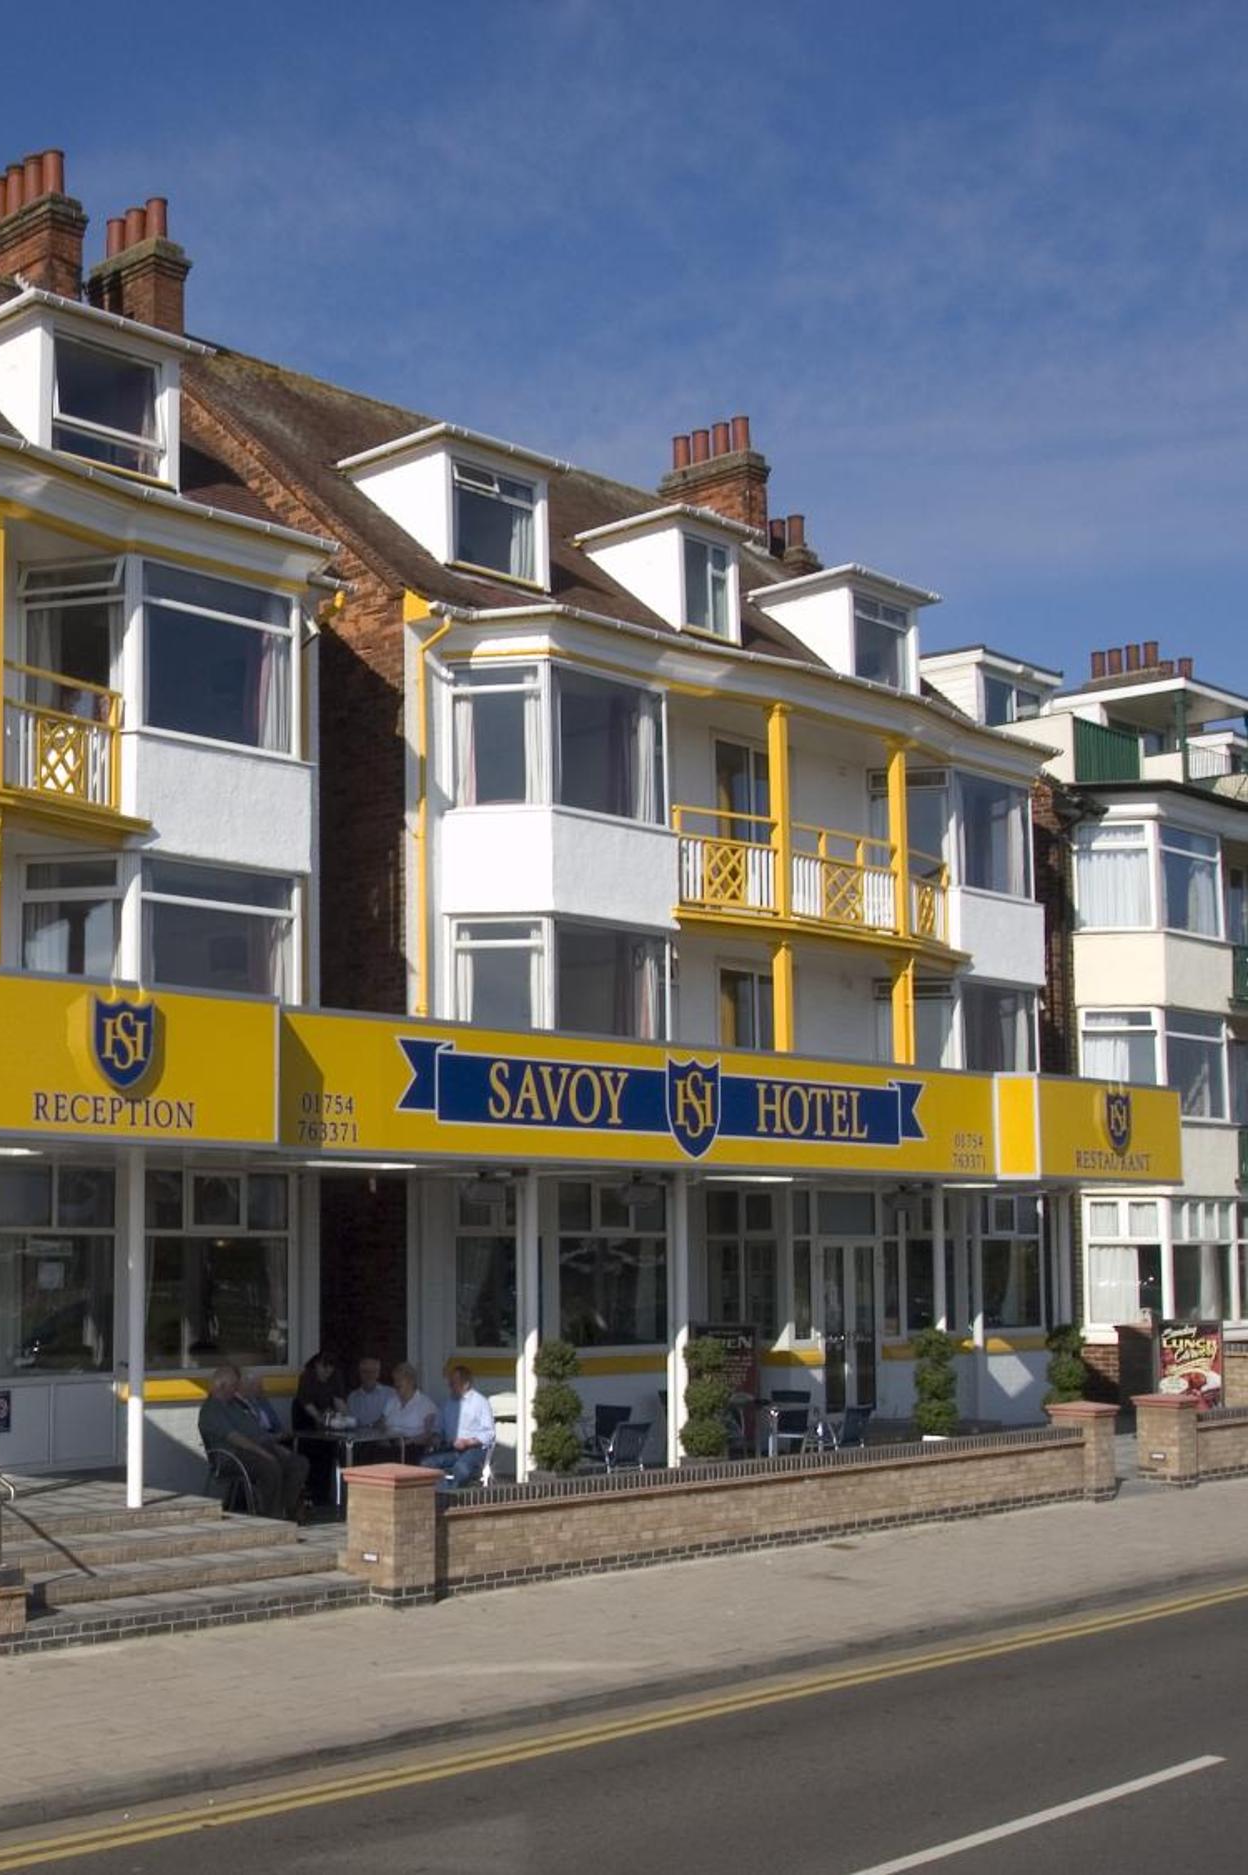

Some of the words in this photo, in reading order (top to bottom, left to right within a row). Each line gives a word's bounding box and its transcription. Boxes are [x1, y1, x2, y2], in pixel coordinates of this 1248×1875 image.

[33, 1092, 195, 1129] RECEPTION
[302, 1092, 354, 1115] 01754
[488, 1061, 629, 1124] SAVOY
[756, 1082, 869, 1139] HOTEL
[298, 1120, 357, 1143] 763371
[1075, 1150, 1151, 1172] RESTAURANT
